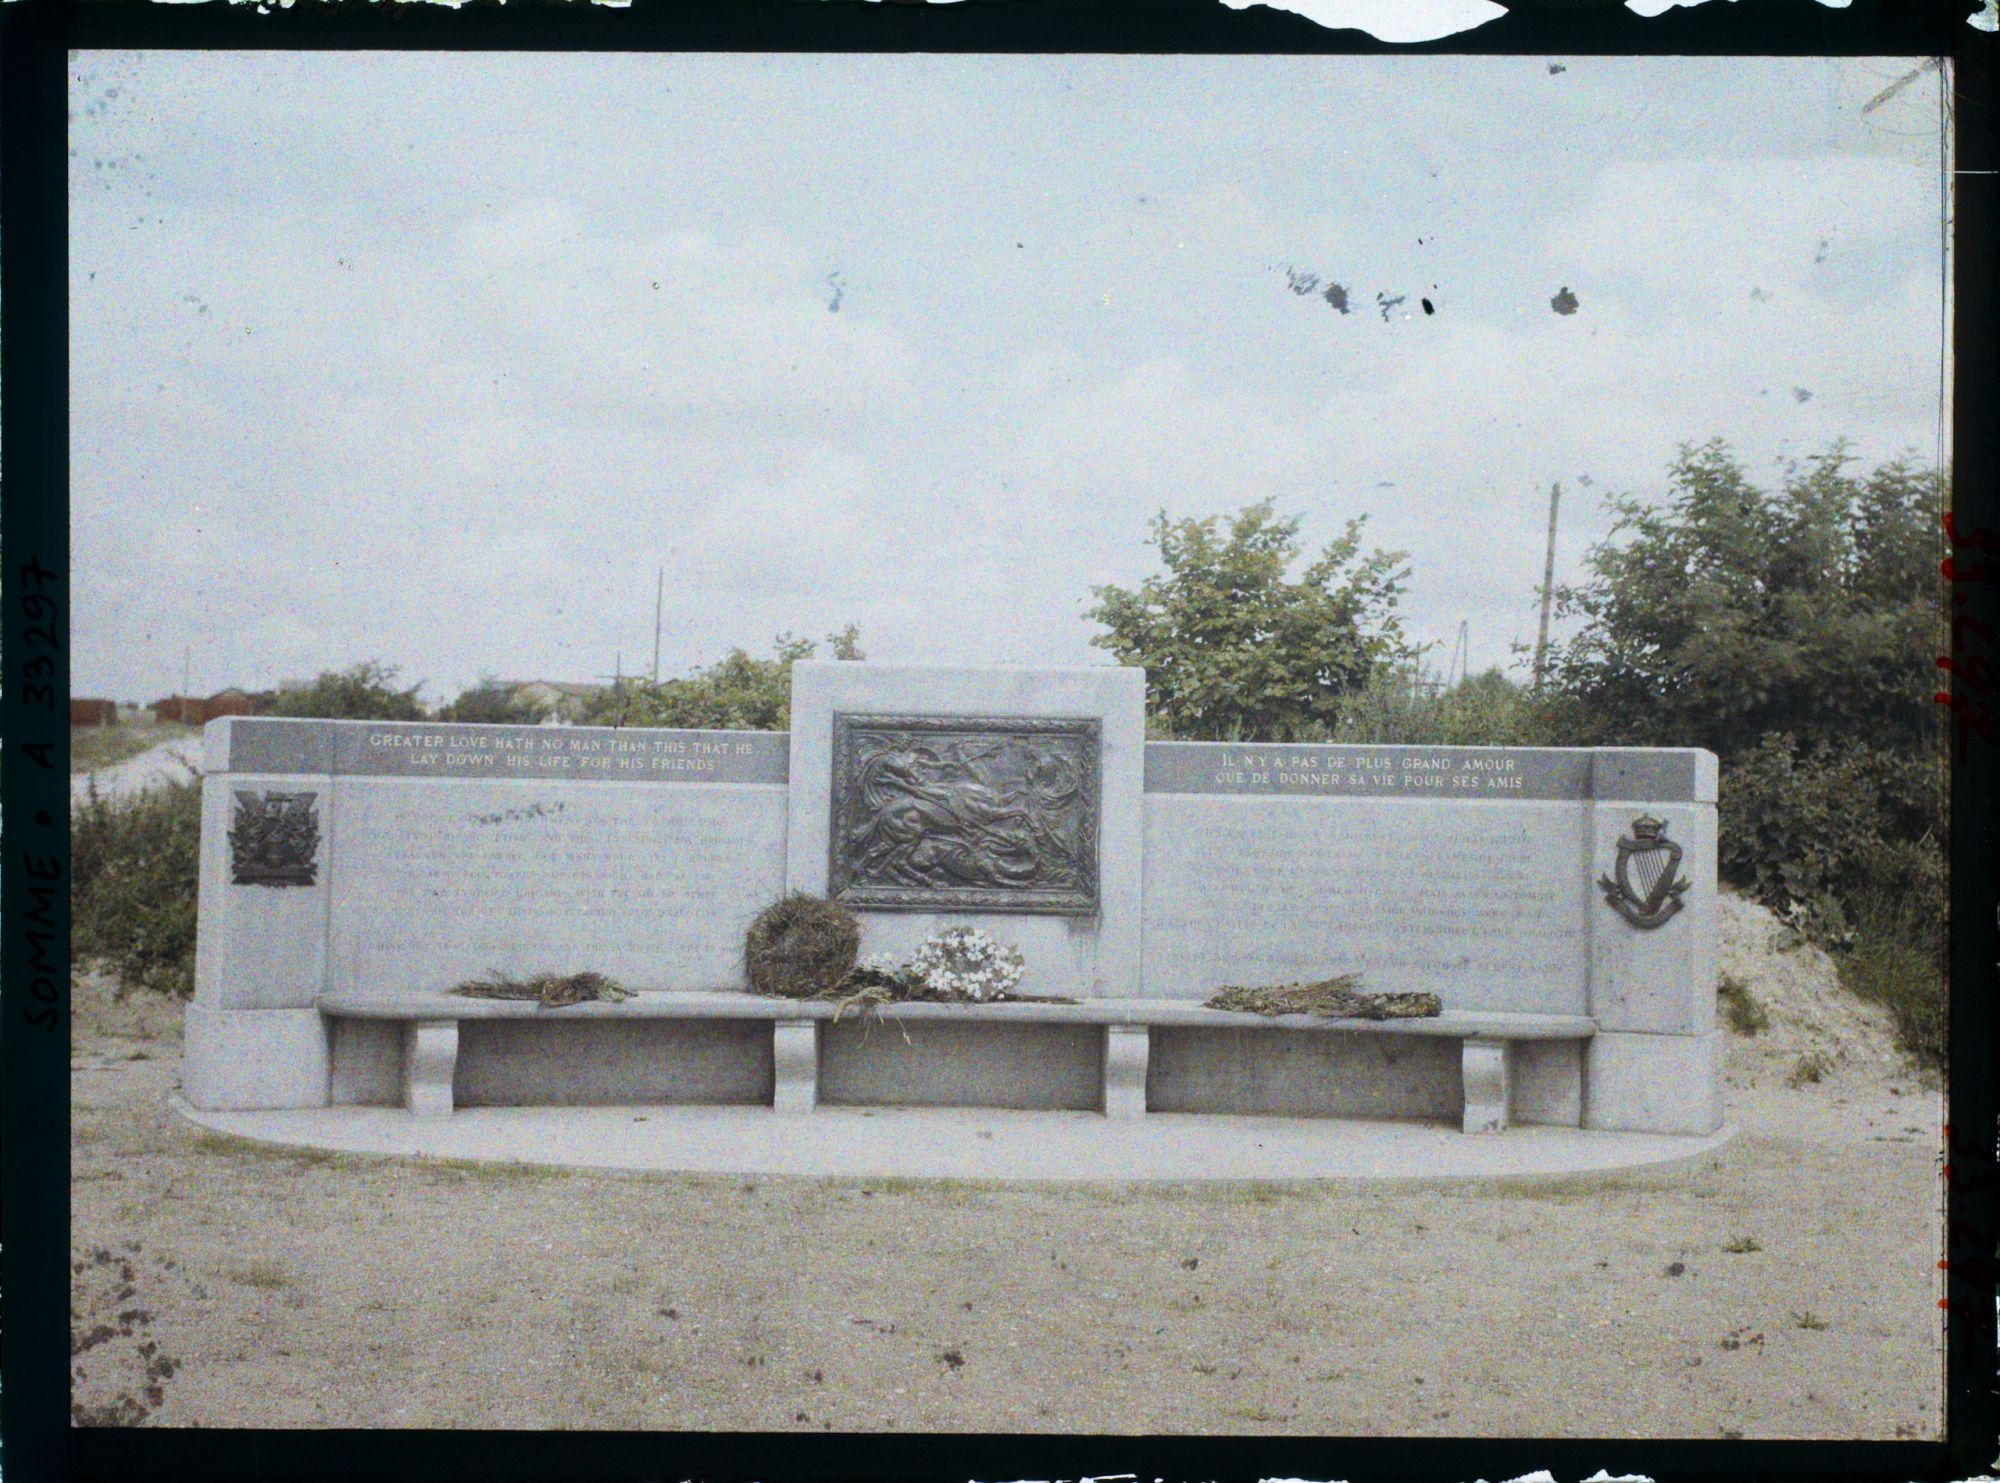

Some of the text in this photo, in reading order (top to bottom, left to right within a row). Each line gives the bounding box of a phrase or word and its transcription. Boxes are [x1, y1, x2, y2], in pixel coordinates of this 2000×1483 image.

[369, 733, 754, 756] GREATER LOVE HATH NO MAN THAN THIS THAT HE
[411, 753, 715, 771] LAY DOWN HIS LIFE FOR HIS FRIENDS
[1222, 751, 1236, 767] IL
[1273, 756, 1284, 768] A
[1292, 756, 1319, 768] PAS
[1327, 756, 1346, 769] DE
[1355, 757, 1392, 769] PLUS
[1401, 758, 1451, 770] GRAND
[1462, 758, 1516, 771] AMOUR
[1215, 772, 1523, 789] QUE DE DONNER SA VIE POUR SES AMIS
[19, 553, 61, 1032] SOMME A 33297
